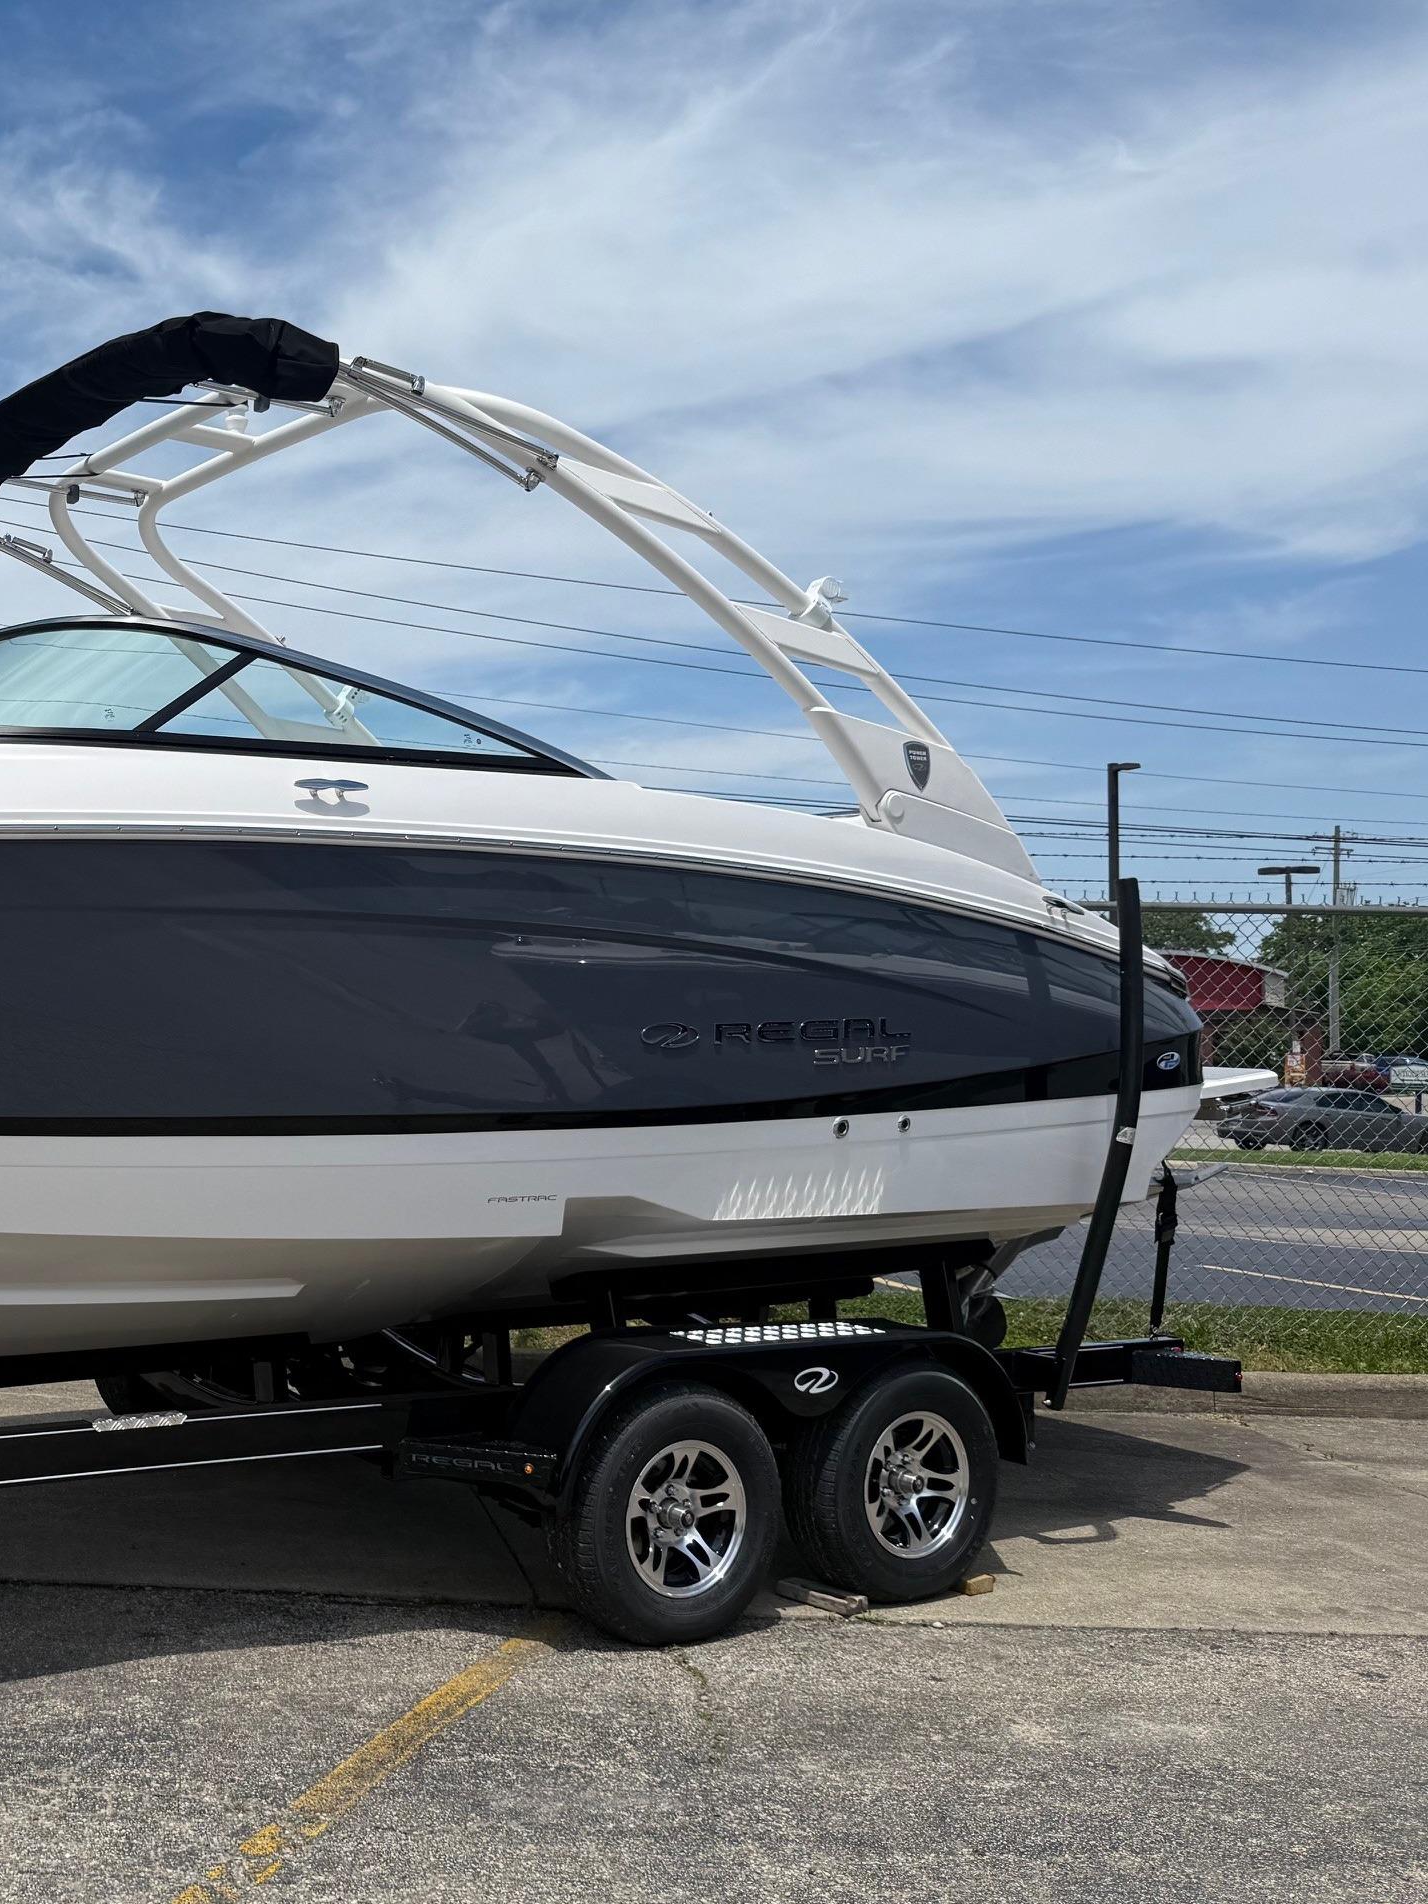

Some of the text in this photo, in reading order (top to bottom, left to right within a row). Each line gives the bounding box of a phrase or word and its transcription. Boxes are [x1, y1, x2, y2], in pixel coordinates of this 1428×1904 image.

[714, 1017, 910, 1045] REGAL
[813, 1045, 910, 1065] SURF
[487, 1194, 557, 1204] FASTRAC
[412, 1453, 516, 1473] REGAL
